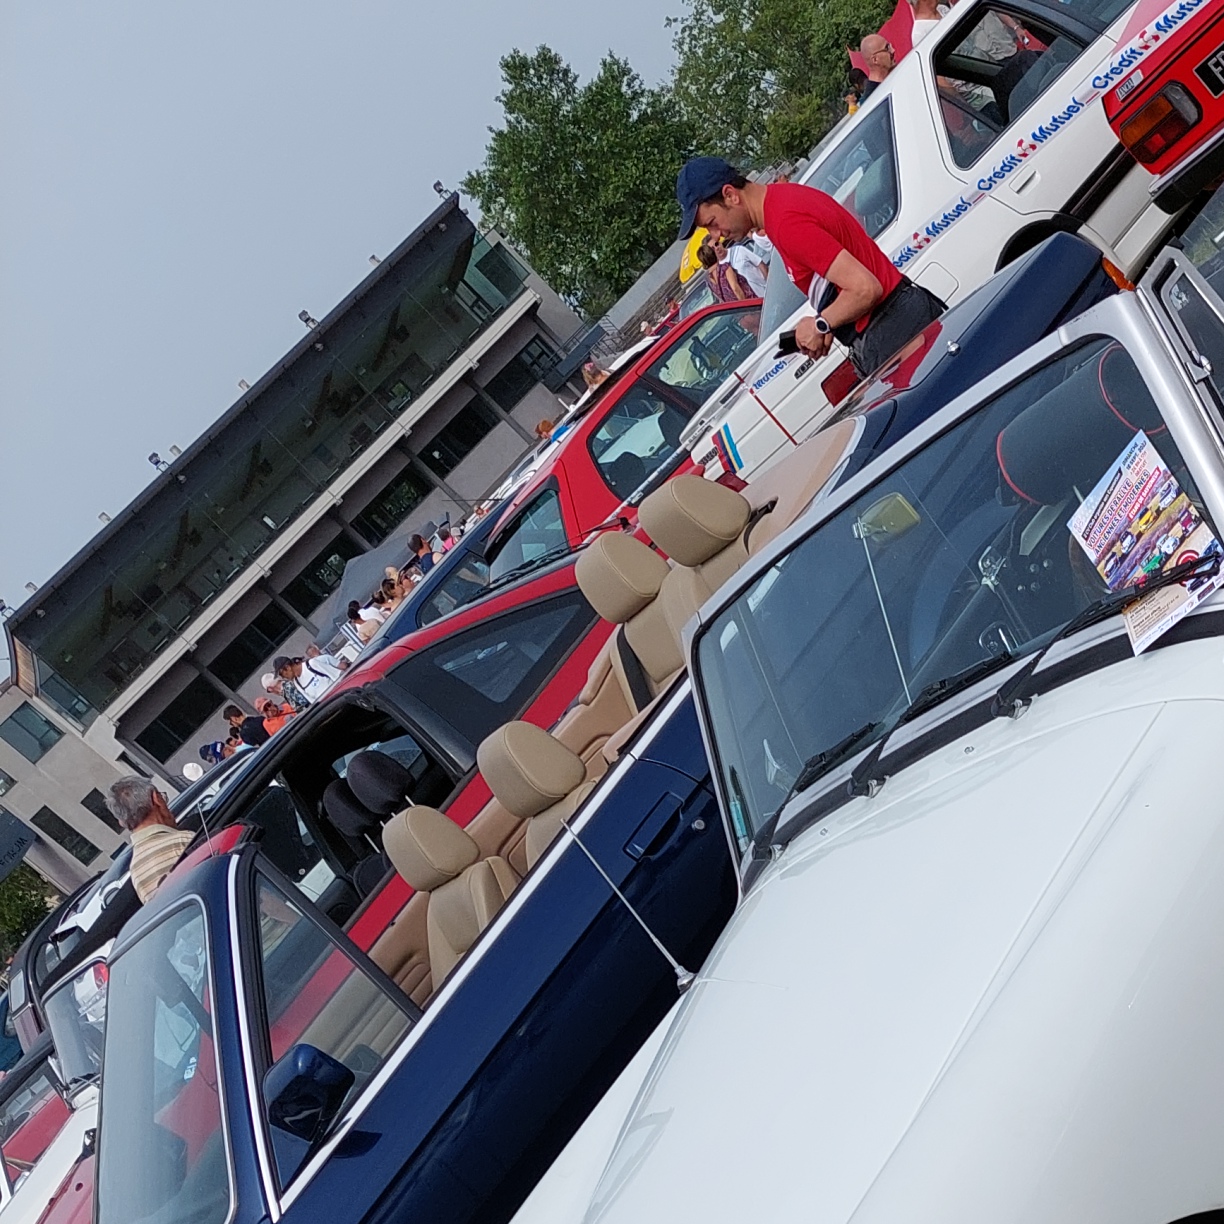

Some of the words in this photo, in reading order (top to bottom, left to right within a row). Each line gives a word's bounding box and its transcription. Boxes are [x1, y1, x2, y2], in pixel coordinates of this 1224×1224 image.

[1092, 46, 1144, 90] Crédit
[1155, 0, 1201, 34] Mutu
[977, 154, 1023, 192] Crédit
[1031, 97, 1085, 143] Mutuel
[893, 245, 918, 269] édit
[925, 196, 973, 238] Mutuel
[1088, 515, 1109, 547] VOITURES
[1107, 504, 1116, 516] DE
[1113, 480, 1131, 507] RALLYE
[1096, 517, 1119, 555] ANCIENNES
[1118, 508, 1126, 519] ET
[1123, 472, 1149, 510] MODERNES
